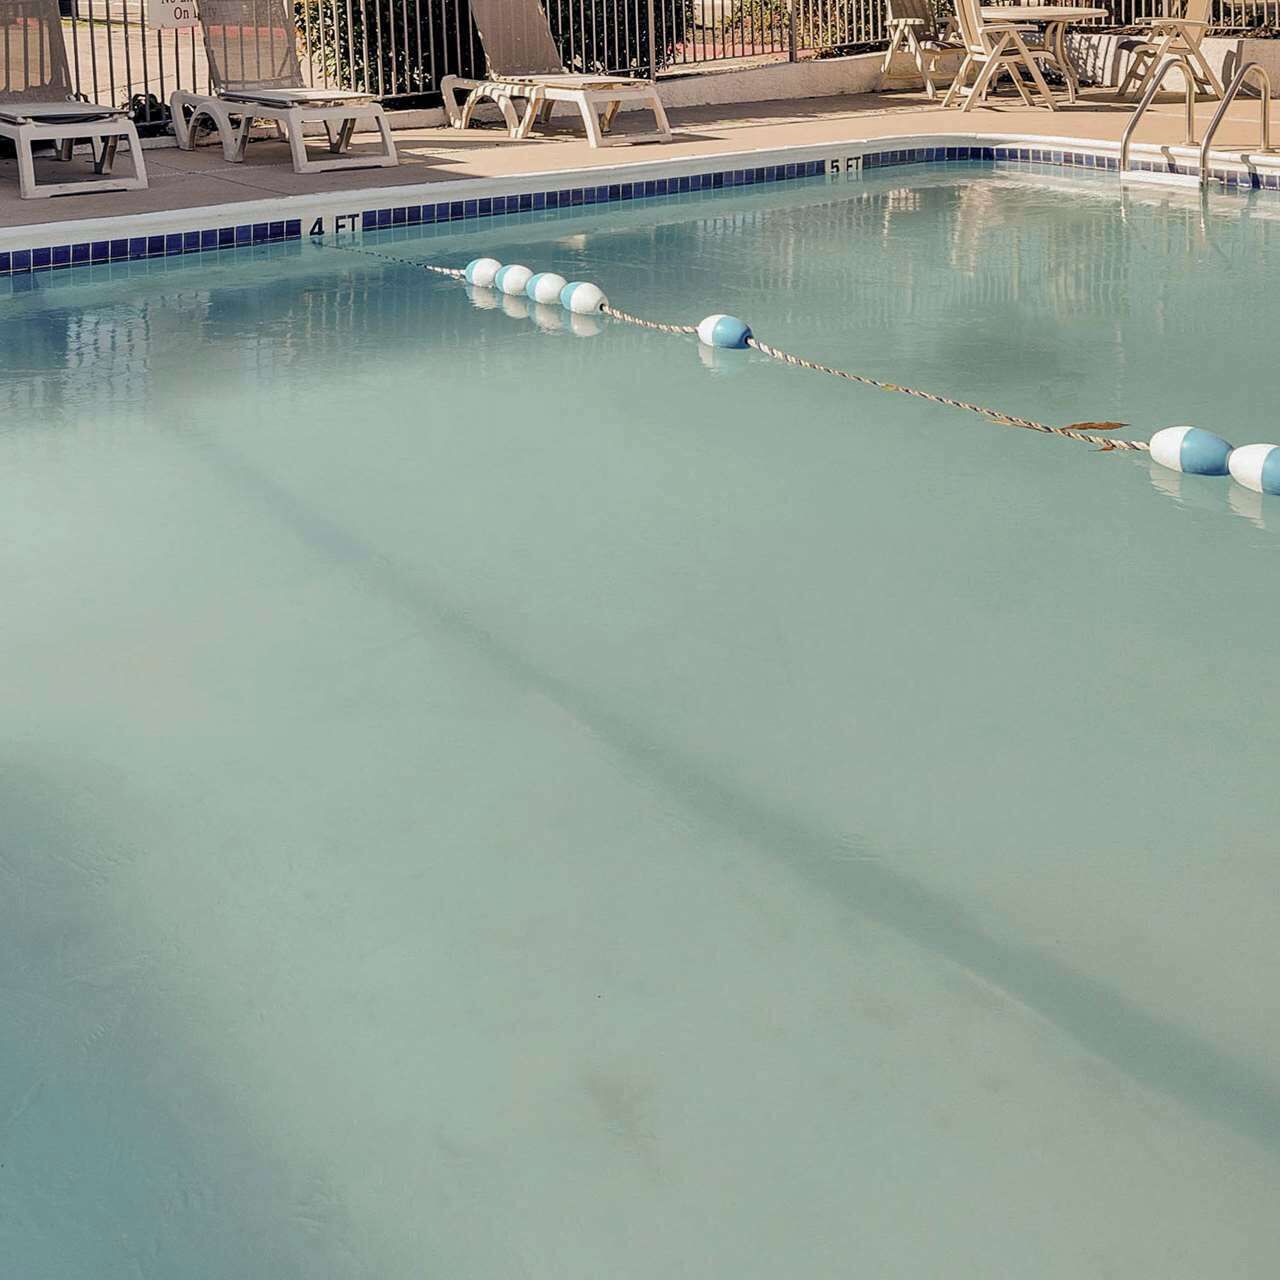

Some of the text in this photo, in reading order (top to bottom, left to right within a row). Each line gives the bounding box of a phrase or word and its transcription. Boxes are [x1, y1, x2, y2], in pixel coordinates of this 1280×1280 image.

[174, 6, 189, 20] On
[830, 156, 861, 173] 5 FT
[309, 213, 359, 236] 4 FT
